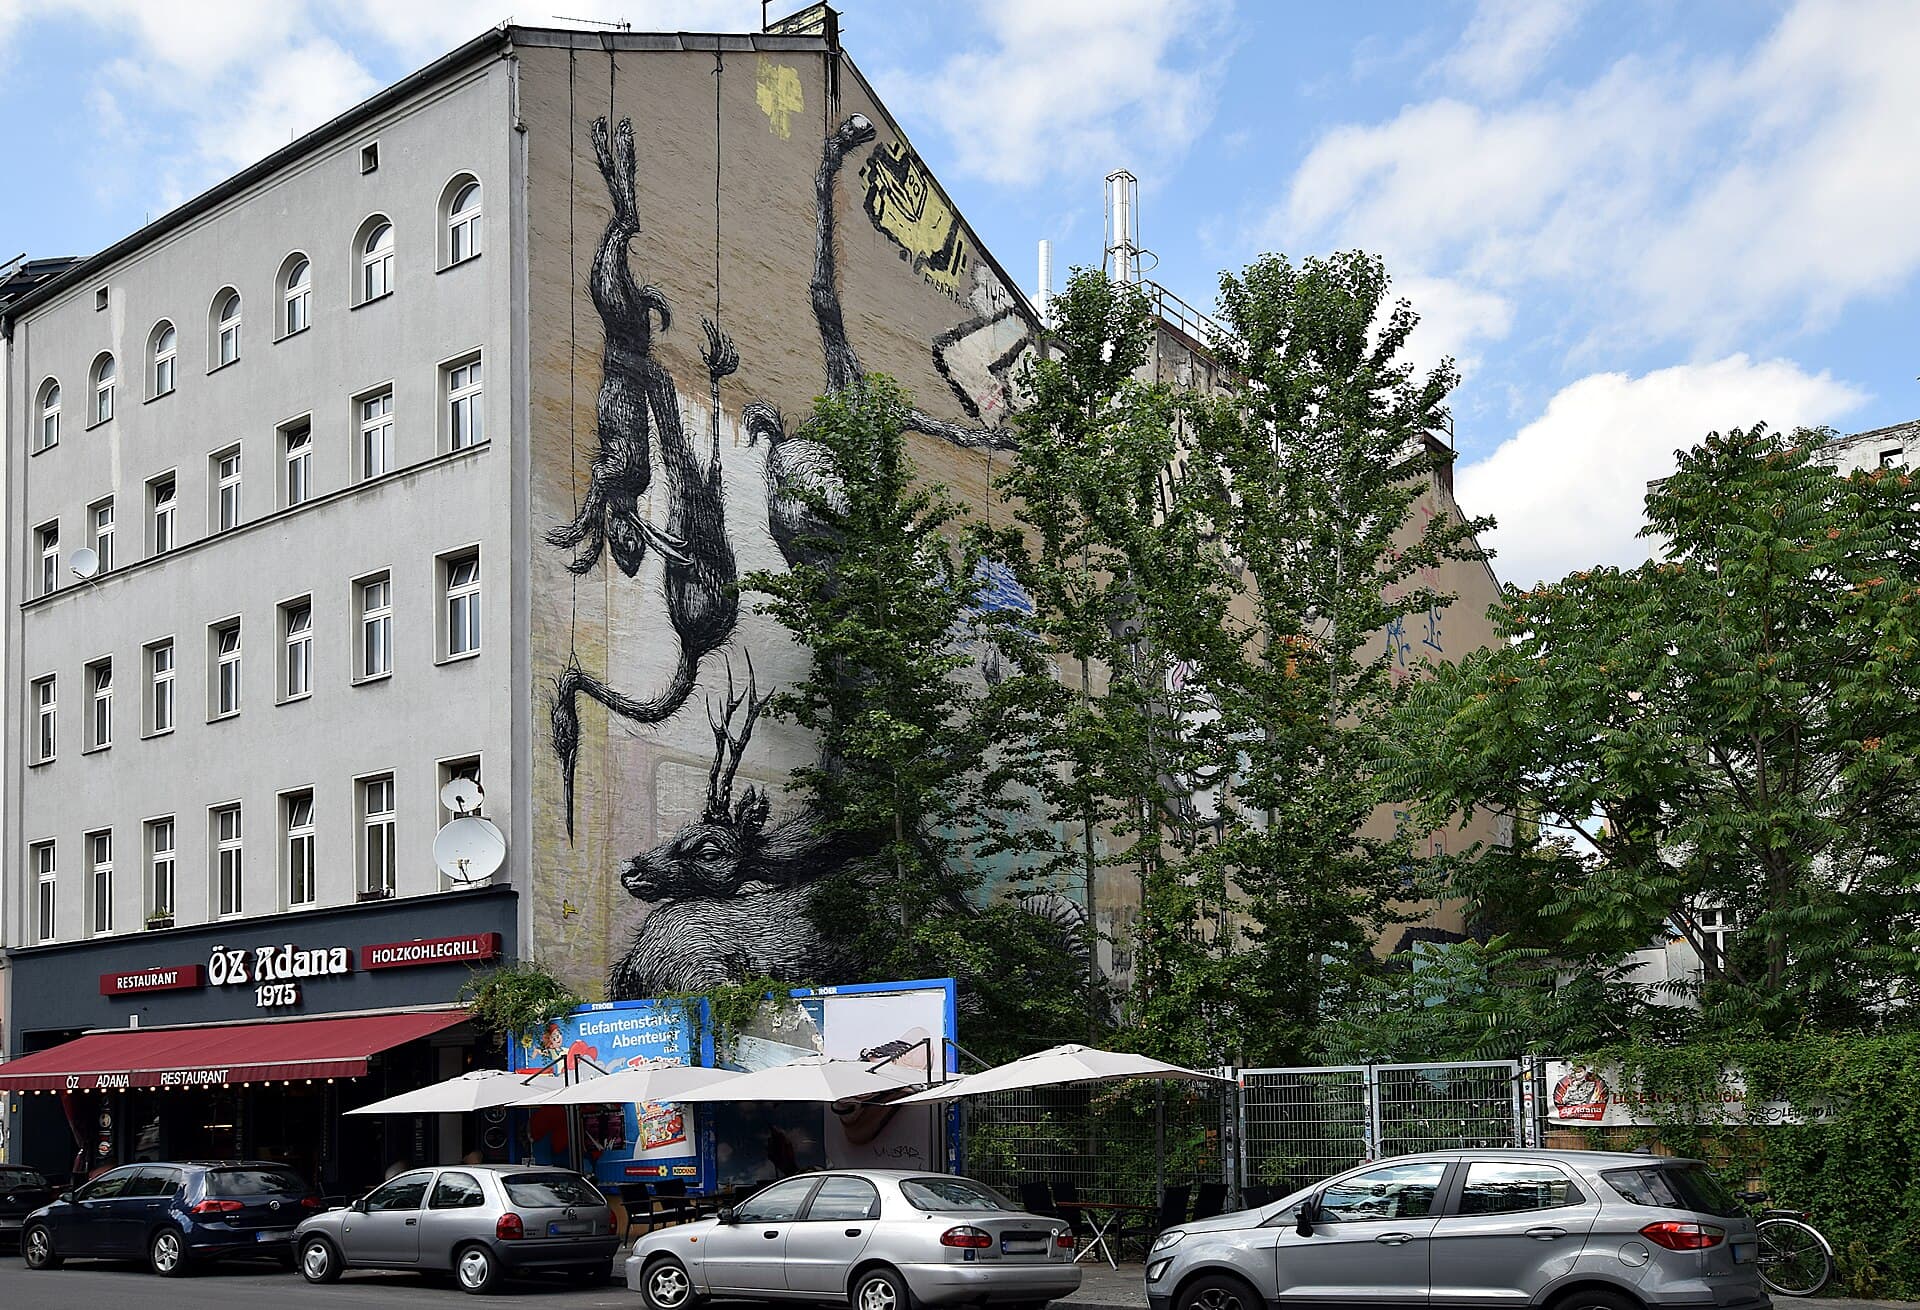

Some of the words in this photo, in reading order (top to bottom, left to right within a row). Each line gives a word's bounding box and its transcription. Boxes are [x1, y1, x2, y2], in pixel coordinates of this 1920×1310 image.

[254, 944, 348, 982] Adana
[372, 940, 480, 964] HOLZKOHLEGRILL
[117, 971, 178, 989] RESTAURANT
[254, 983, 297, 1007] 1975
[66, 1075, 80, 1089] ÖZ
[95, 1074, 130, 1088] ADANA
[160, 1069, 229, 1085] RESTAURANT
